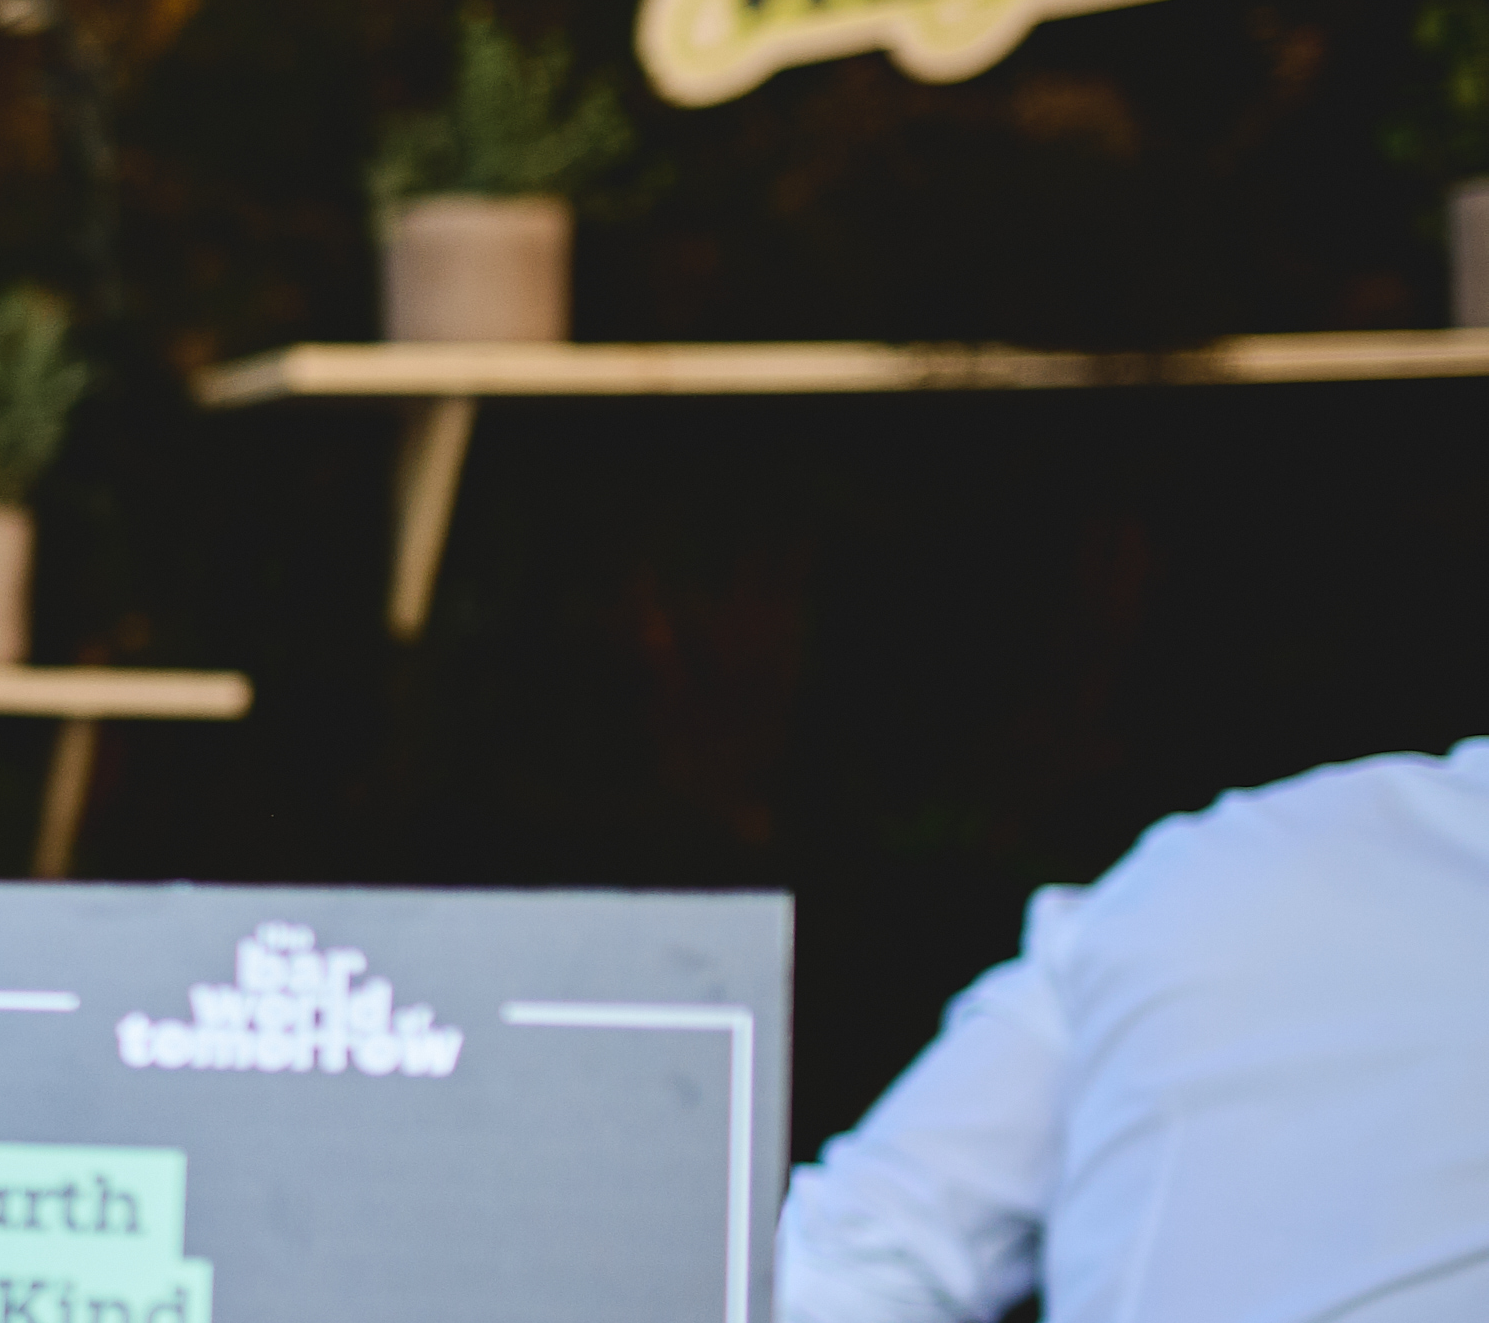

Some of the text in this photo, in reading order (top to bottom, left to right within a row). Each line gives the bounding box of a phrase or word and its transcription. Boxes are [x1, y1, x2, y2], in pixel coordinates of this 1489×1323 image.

[236, 936, 367, 994] bar
[187, 976, 393, 1028] world
[115, 1011, 464, 1077] tomorrow
